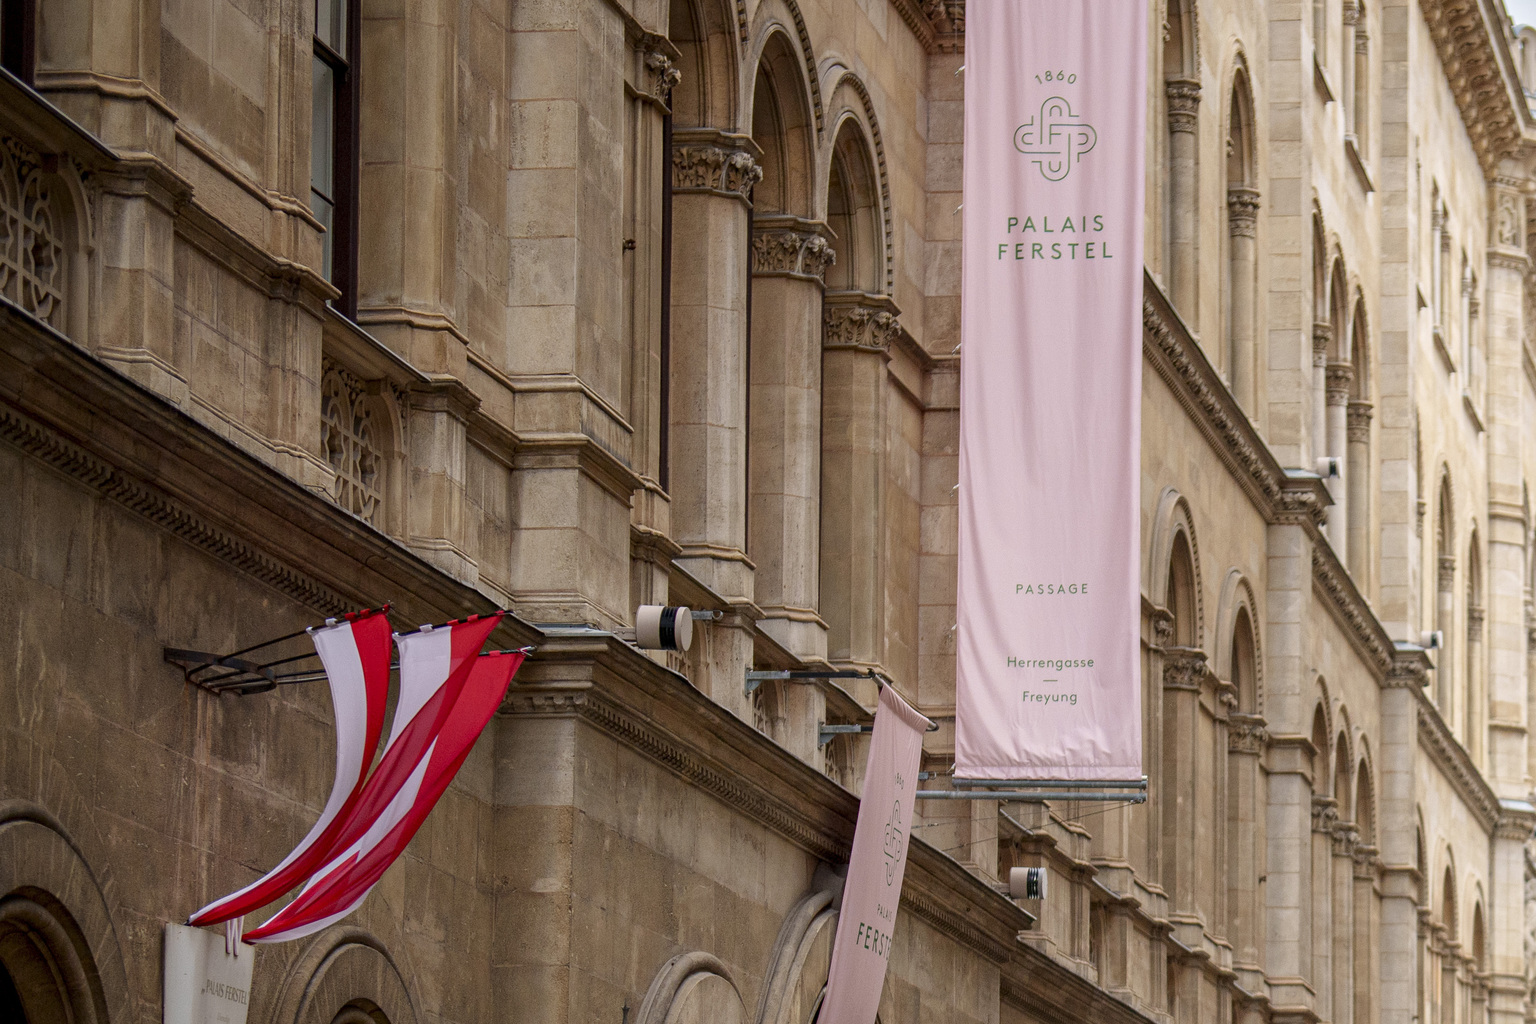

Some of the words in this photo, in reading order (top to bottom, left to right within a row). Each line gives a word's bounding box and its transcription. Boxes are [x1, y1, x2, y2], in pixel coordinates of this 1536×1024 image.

[1034, 69, 1077, 85] 1860
[1007, 215, 1105, 234] PALAIS
[998, 241, 1113, 260] FERSTEL
[1015, 583, 1089, 595] PASSAGE
[1006, 656, 1095, 672] Herrengasse
[1022, 690, 1078, 706] Freyung
[225, 985, 248, 1006] FERSTEL
